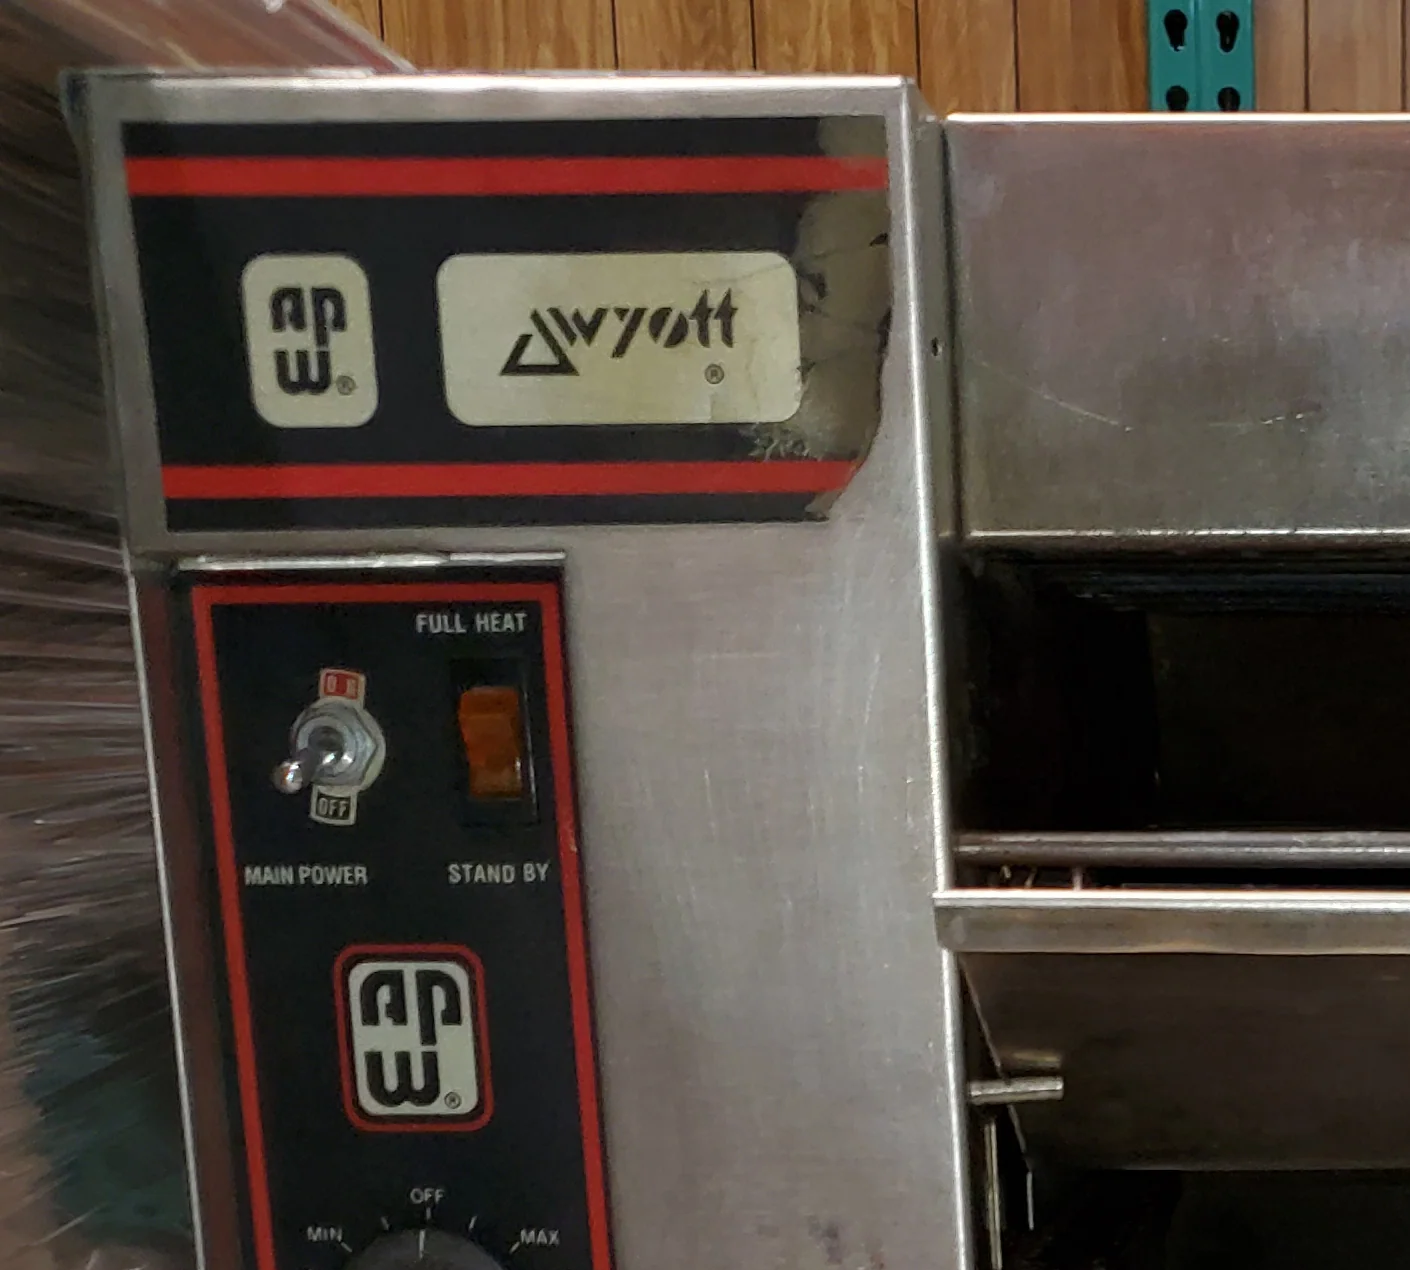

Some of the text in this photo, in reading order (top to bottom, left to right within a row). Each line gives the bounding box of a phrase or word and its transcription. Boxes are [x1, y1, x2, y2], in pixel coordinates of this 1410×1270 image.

[415, 612, 528, 634] FULL HEAT
[318, 797, 349, 818] OFF
[244, 865, 368, 886] MAIN POWER
[448, 861, 551, 884] STAND BY
[410, 1187, 445, 1204] OFF
[307, 1227, 343, 1242] MIN
[520, 1229, 560, 1245] MAX
